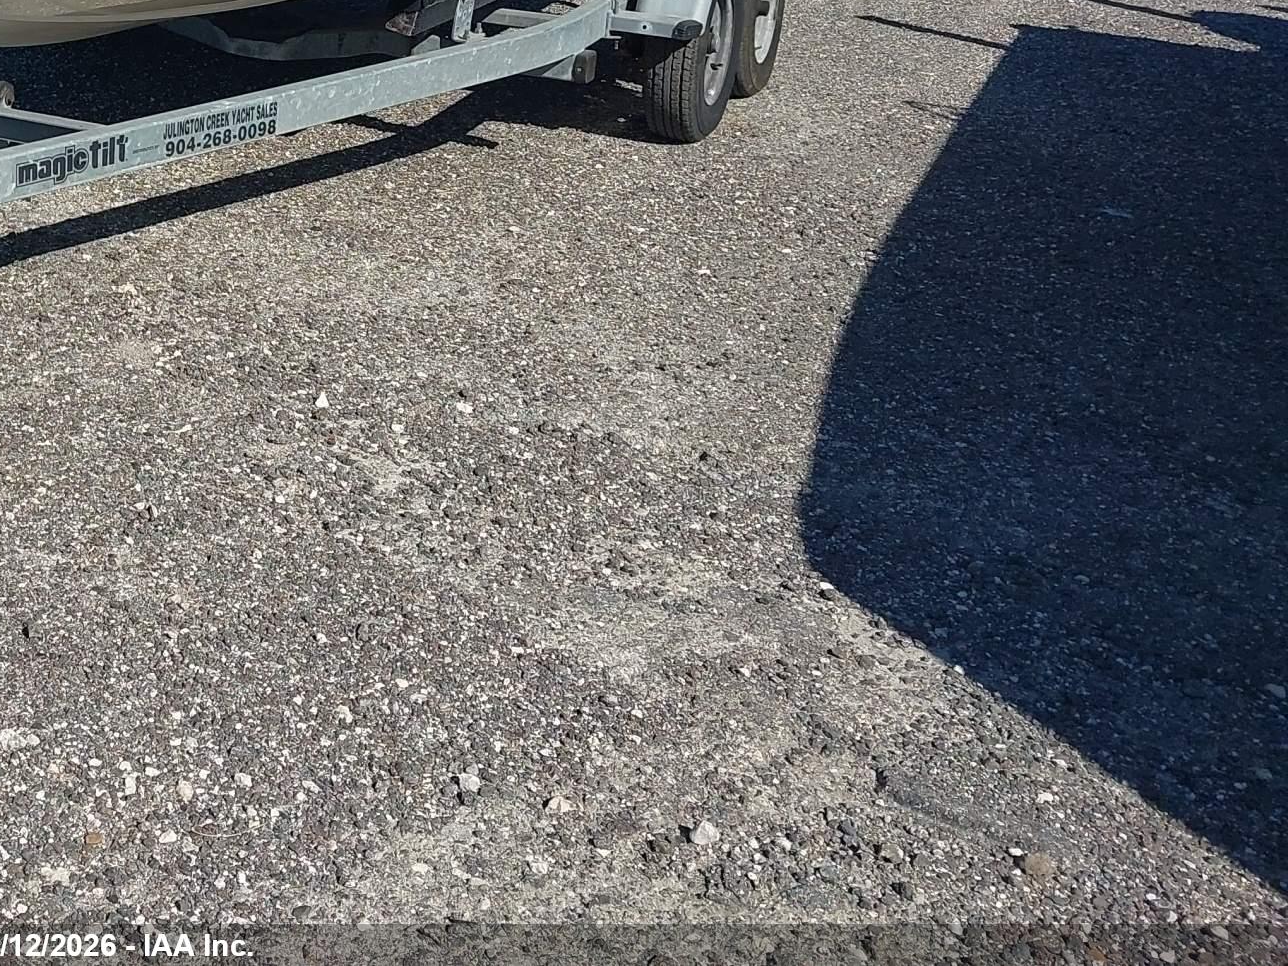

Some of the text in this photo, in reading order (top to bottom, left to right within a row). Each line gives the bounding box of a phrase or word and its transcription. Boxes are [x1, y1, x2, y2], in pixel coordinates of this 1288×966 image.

[163, 101, 278, 140] JULINGTON CREEK YACHT SALES
[165, 119, 277, 157] 904-268-0098
[17, 146, 88, 183] magic
